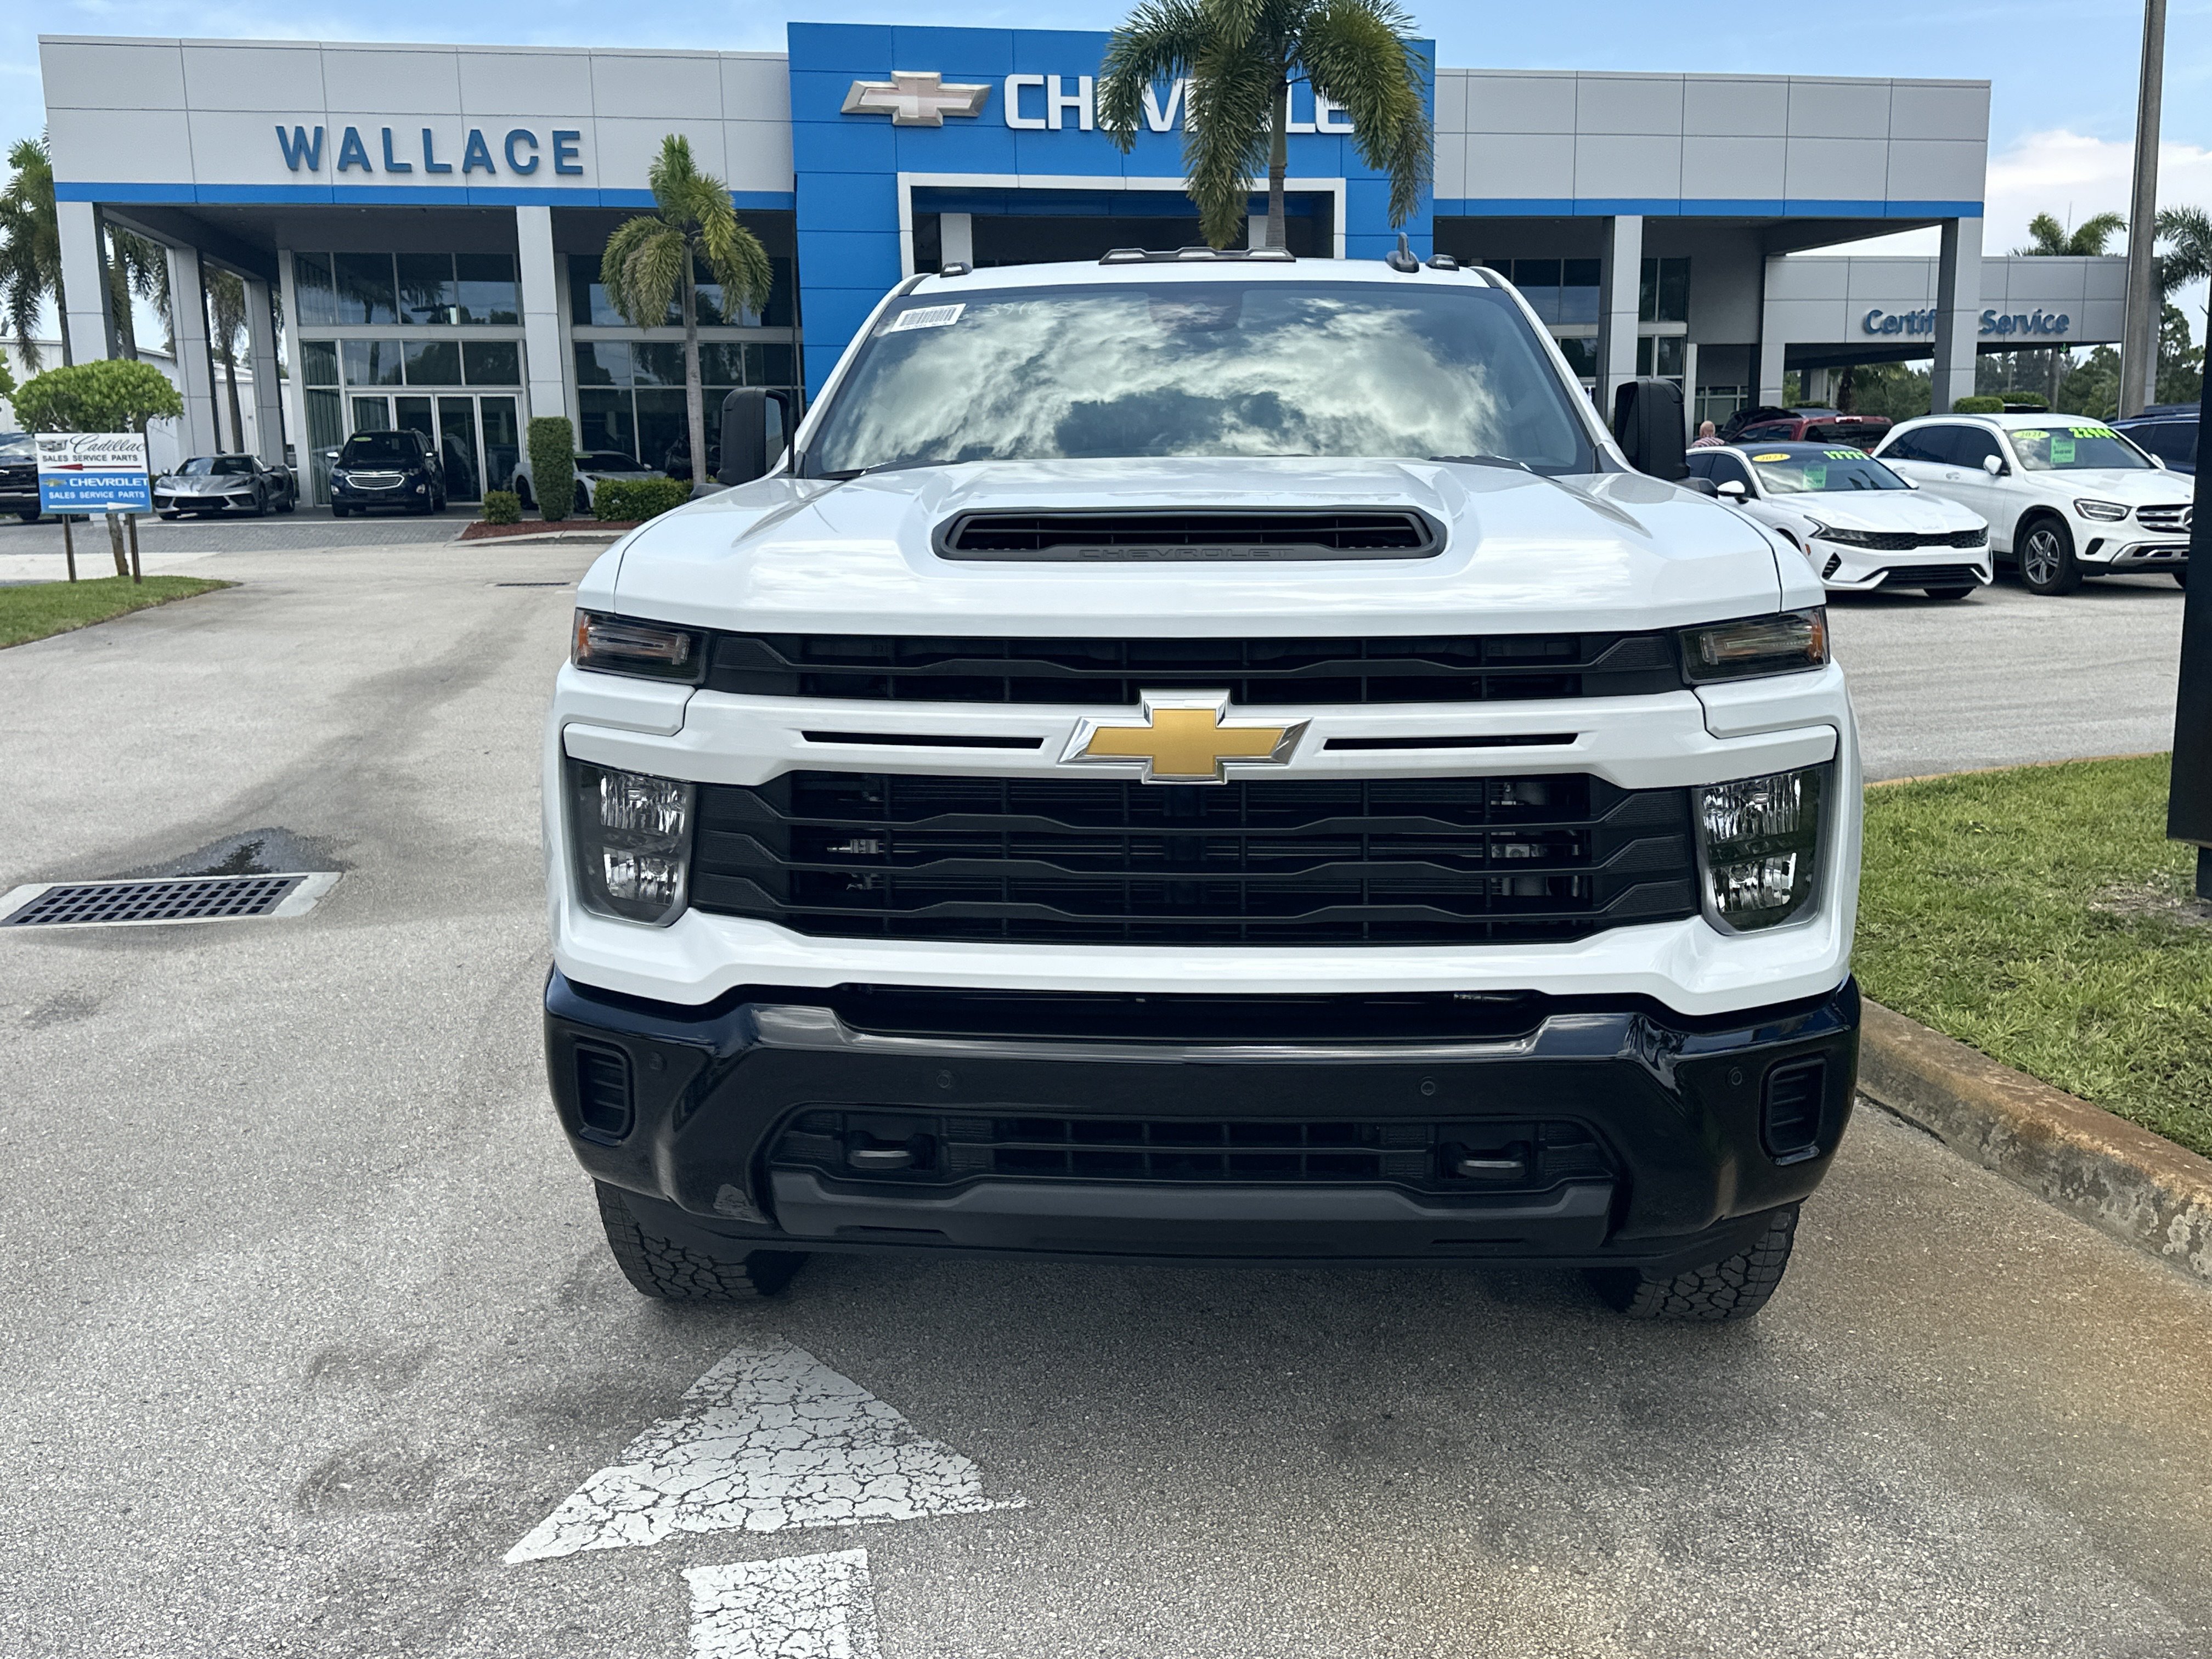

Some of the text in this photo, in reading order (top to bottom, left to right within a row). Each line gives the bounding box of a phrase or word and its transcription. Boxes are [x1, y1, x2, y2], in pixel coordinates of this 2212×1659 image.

[275, 126, 583, 175] WALLACE
[1865, 308, 2069, 334] Certif Service
[70, 434, 145, 454] Cadillac
[70, 477, 148, 487] CHEVROLET
[1079, 548, 1295, 558] CHEVROLET
